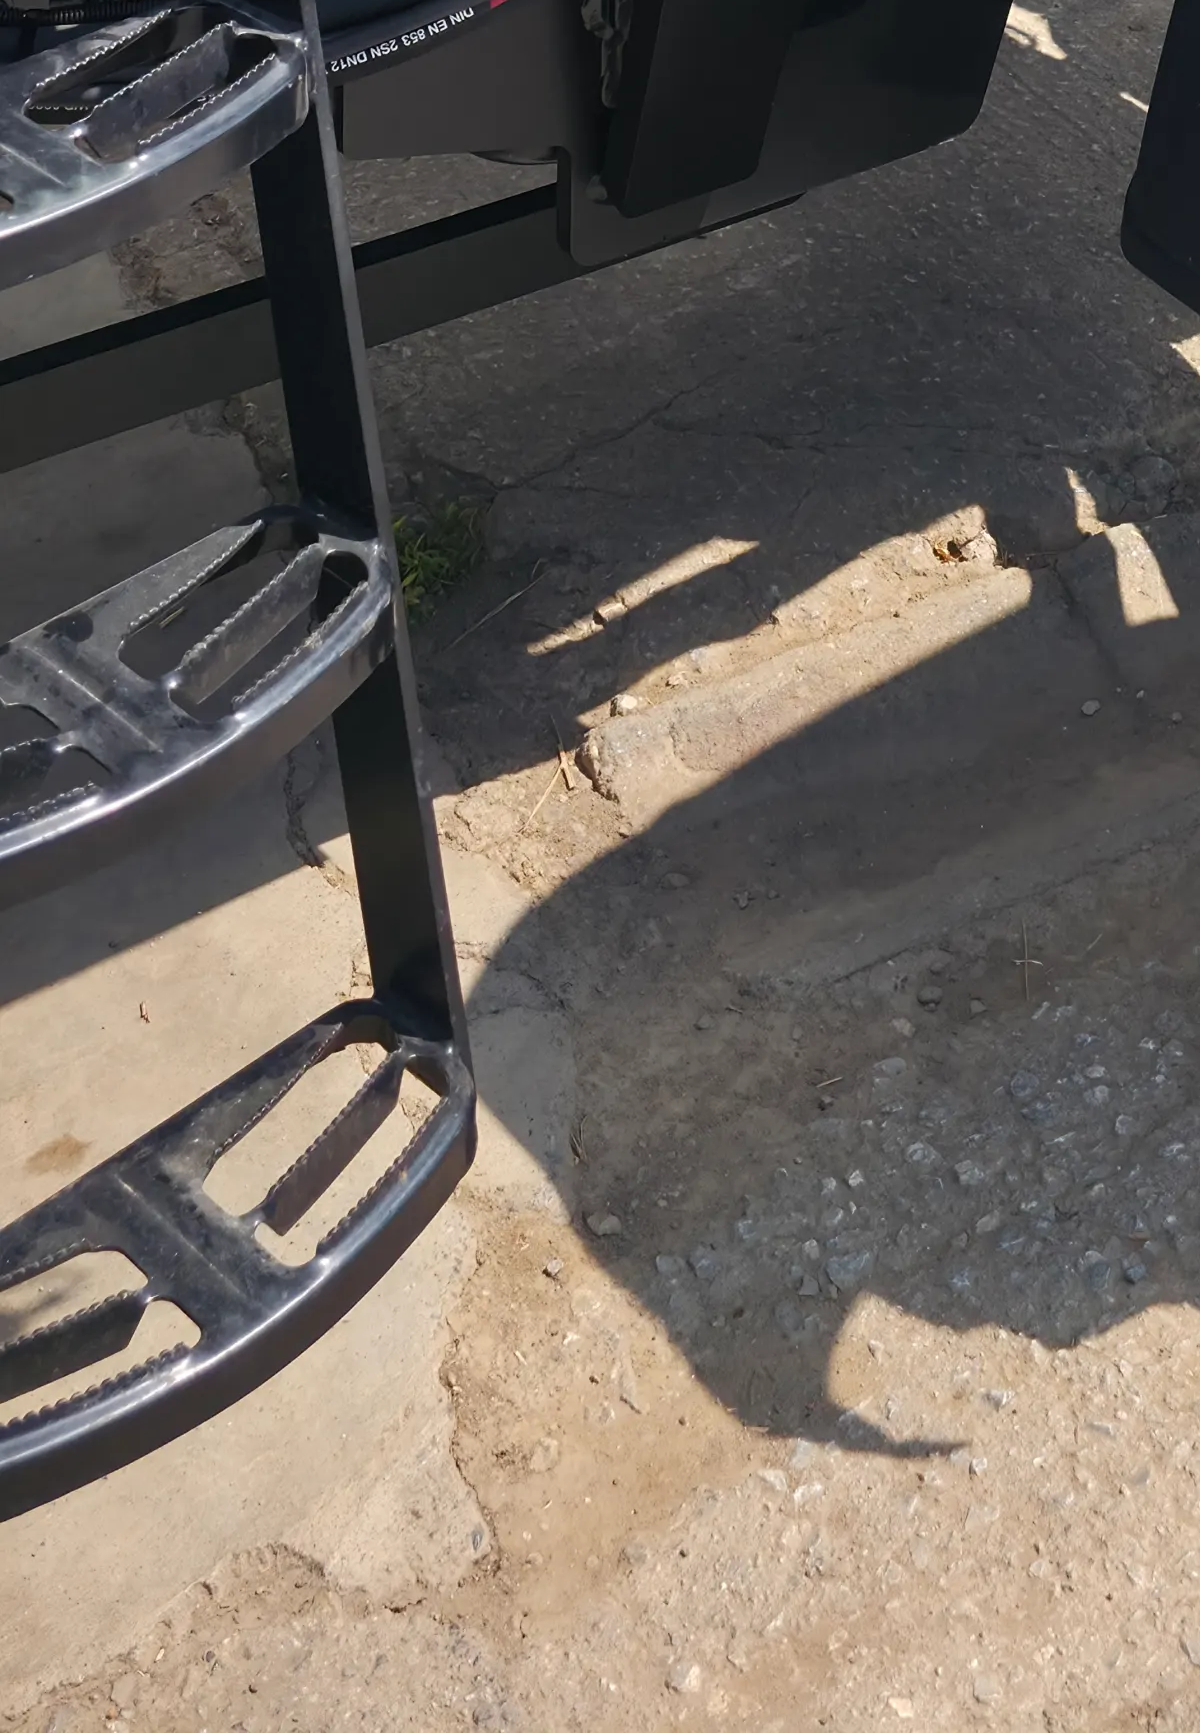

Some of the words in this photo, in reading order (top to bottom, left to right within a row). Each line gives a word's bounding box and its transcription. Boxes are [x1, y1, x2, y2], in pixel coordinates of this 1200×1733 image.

[426, 18, 449, 36] EN
[400, 28, 427, 47] 853
[369, 39, 399, 60] 2SN
[329, 50, 369, 72] DN12
